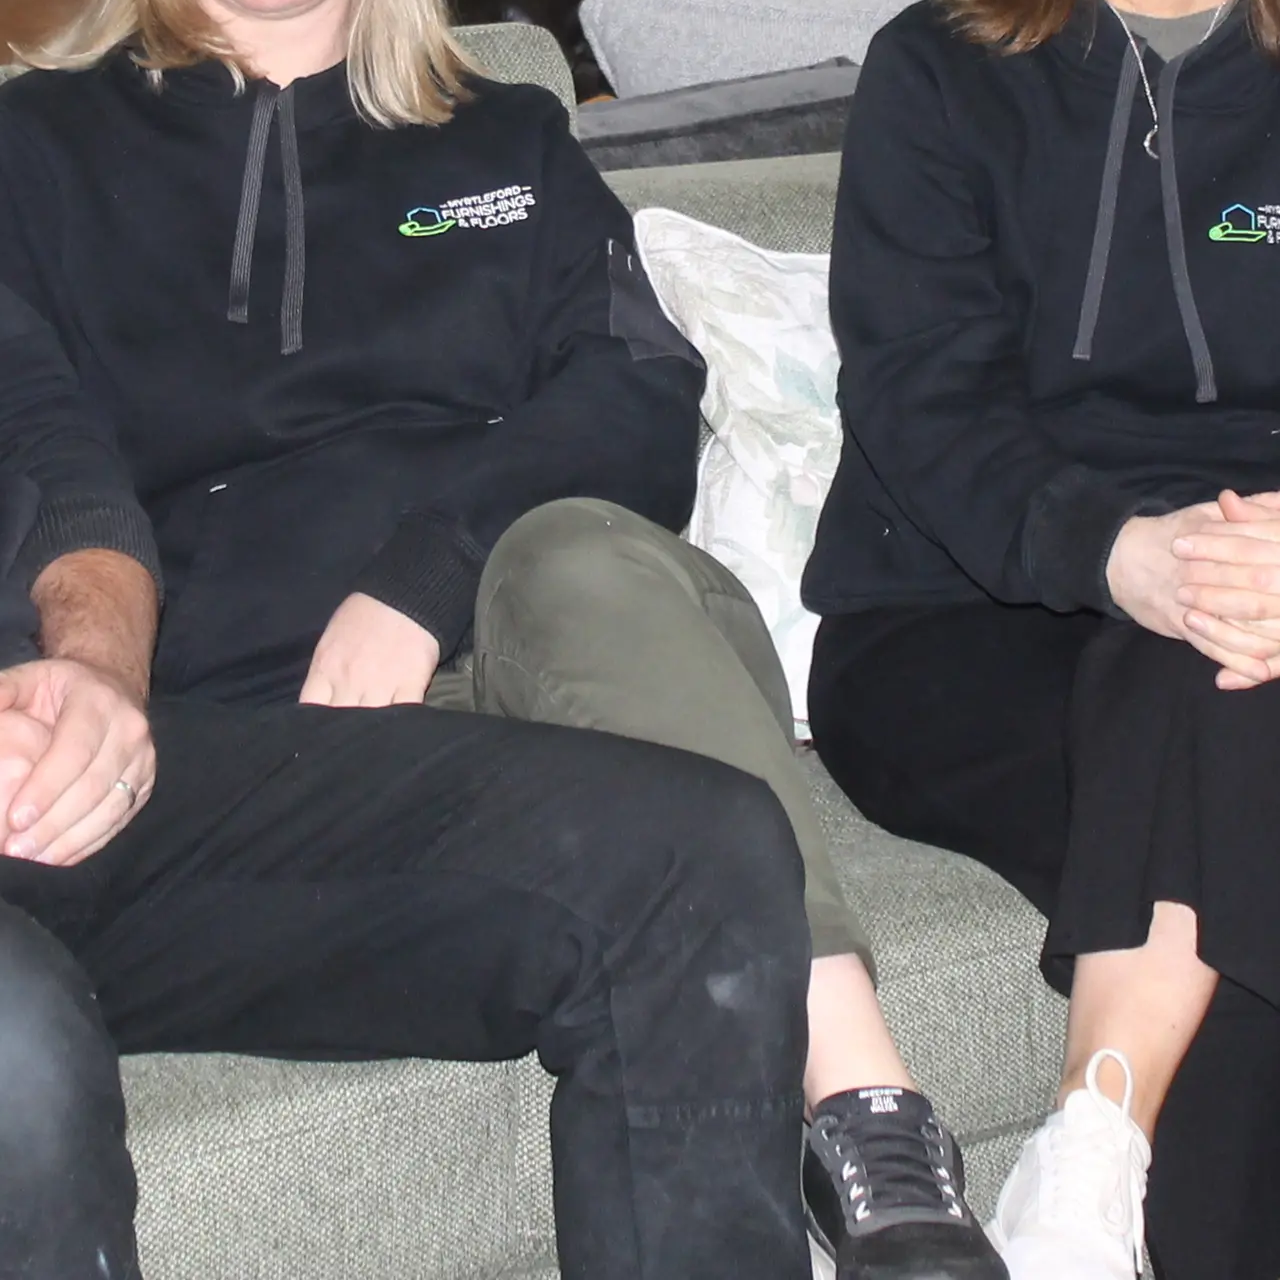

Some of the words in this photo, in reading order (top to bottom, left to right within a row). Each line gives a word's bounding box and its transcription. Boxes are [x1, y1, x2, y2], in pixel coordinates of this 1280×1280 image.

[441, 194, 536, 220] FURNISHINGS
[447, 185, 521, 208] MYRTLEFORD
[458, 218, 470, 228] &
[470, 208, 528, 229] FLOORS
[1266, 230, 1274, 244] &
